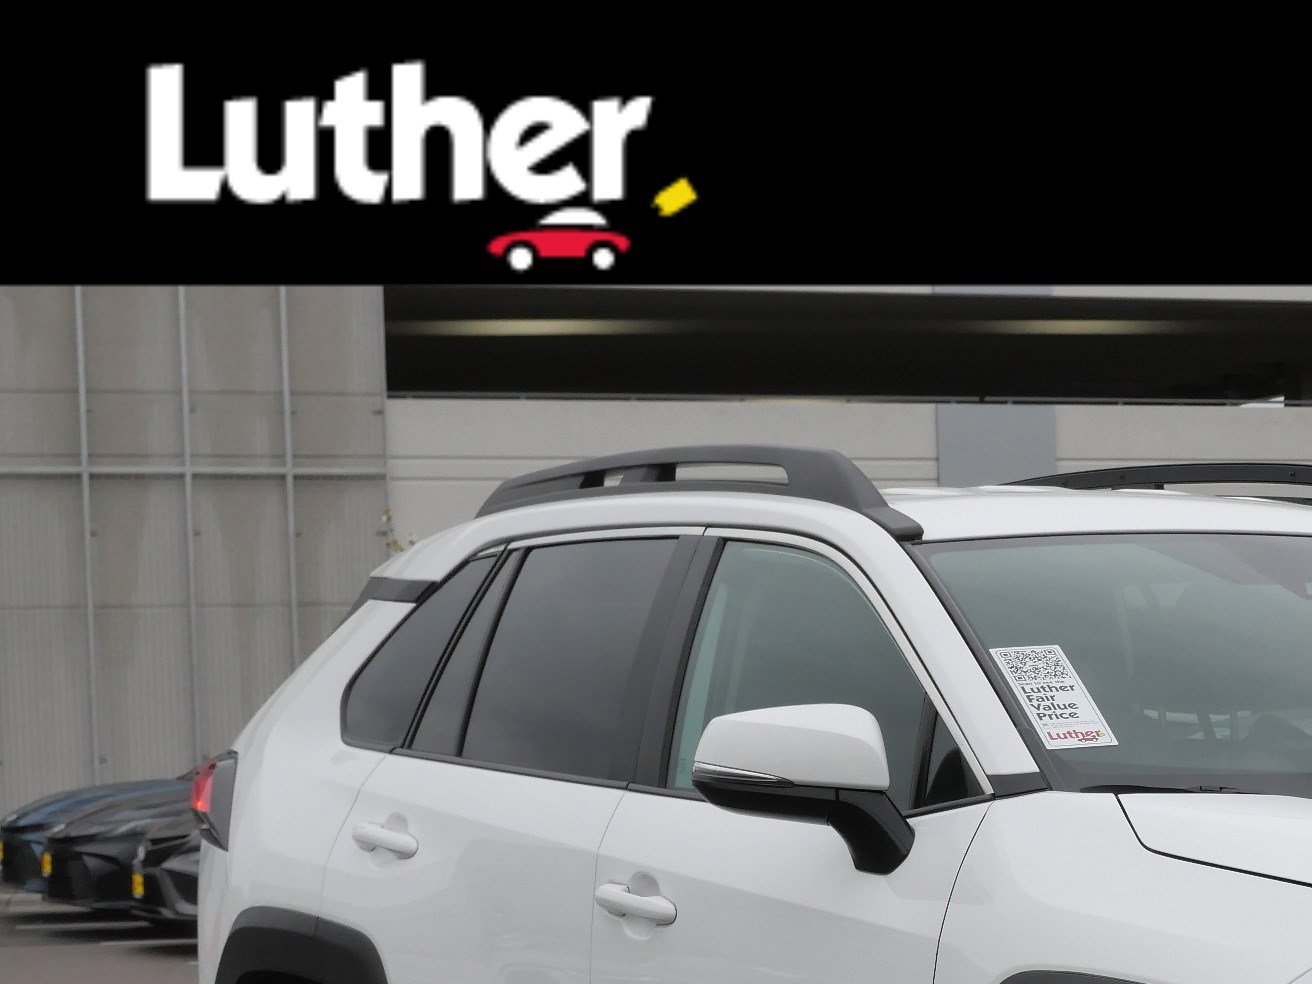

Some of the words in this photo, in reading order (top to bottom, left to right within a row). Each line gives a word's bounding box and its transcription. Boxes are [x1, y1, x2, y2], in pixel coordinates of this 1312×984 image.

[1021, 684, 1075, 694] Luther
[1026, 693, 1056, 703] Fair
[1030, 702, 1079, 712] Value
[1036, 711, 1080, 721] Price
[1047, 729, 1102, 741] Luther
